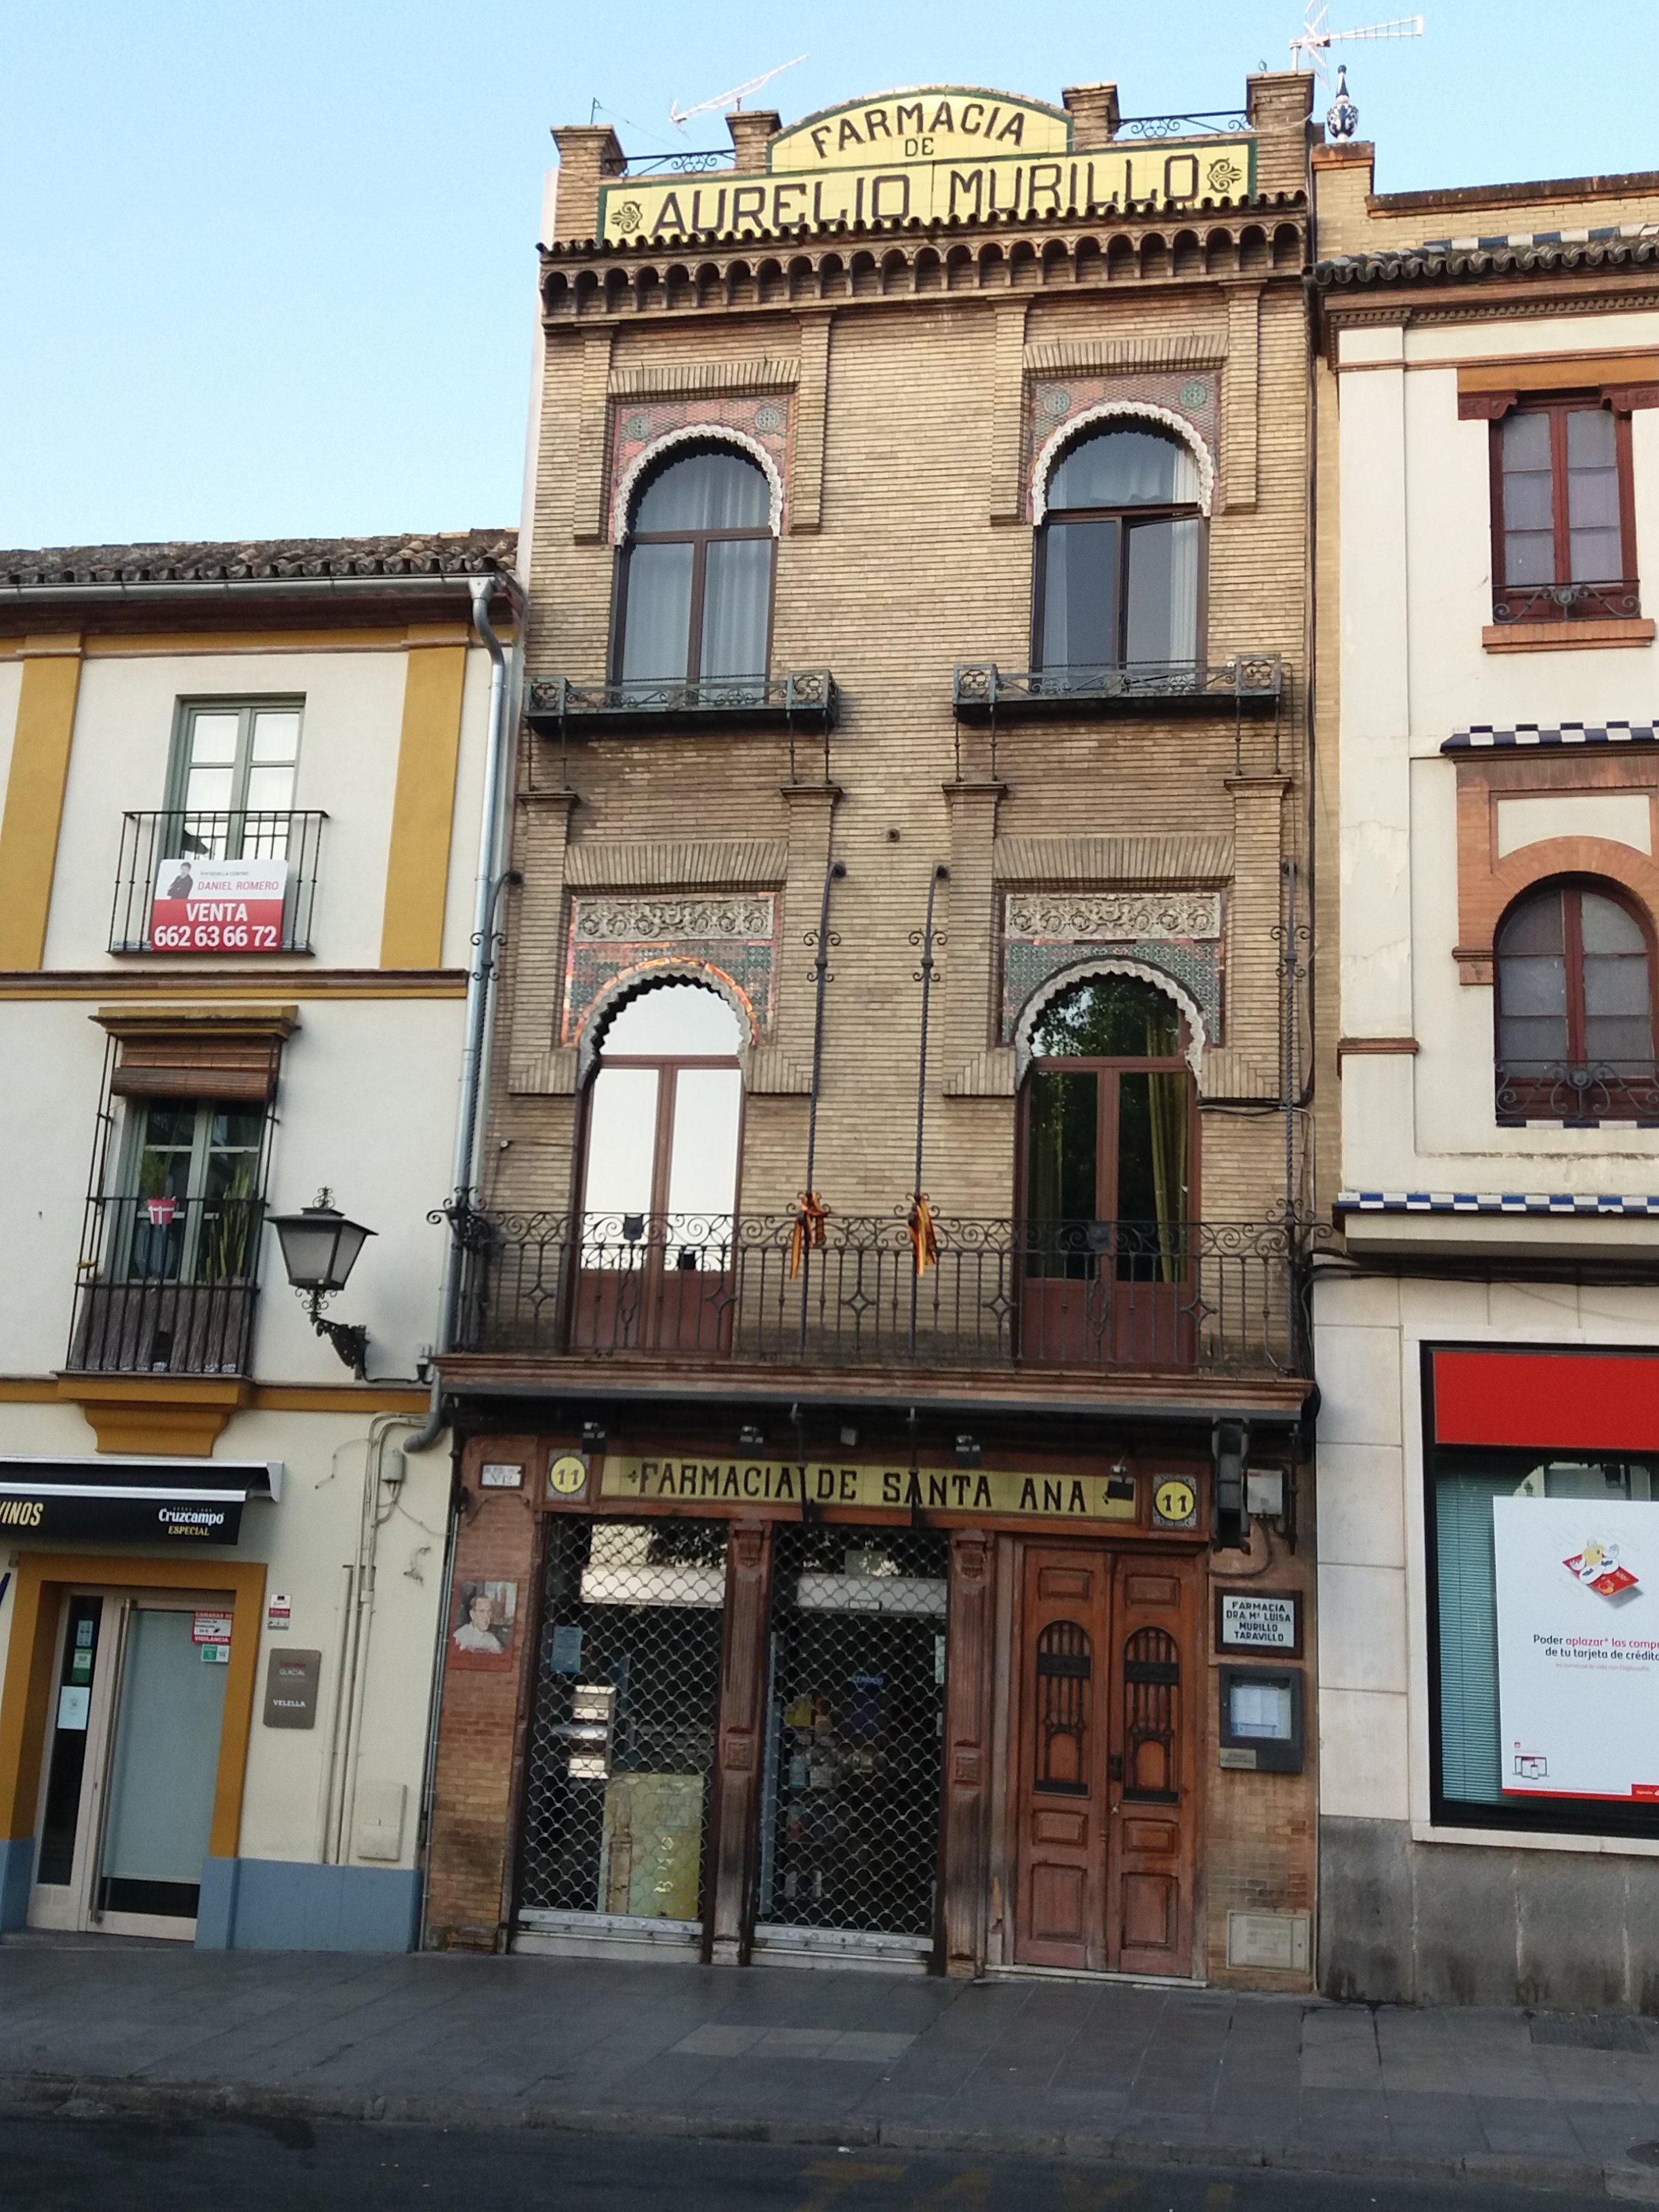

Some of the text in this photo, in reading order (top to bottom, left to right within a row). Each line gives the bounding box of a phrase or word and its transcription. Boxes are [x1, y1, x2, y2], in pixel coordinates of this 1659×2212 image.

[811, 100, 1025, 159] FARMACIA
[904, 137, 935, 157] DE
[650, 154, 1199, 237] AURELIO MURILLO
[198, 881, 279, 890] DANIEL ROMERO
[186, 903, 248, 922] VENTA
[154, 926, 278, 947] 662 63 66 72
[557, 1468, 579, 1486] 11
[640, 1462, 1086, 1513] FARMACIA DE SANTA ANA
[1162, 1494, 1187, 1513] 11
[159, 1507, 224, 1526] Cruzcampo
[168, 1525, 210, 1536] ESPECIAL
[1232, 1601, 1286, 1612] FARMACIA
[1226, 1610, 1246, 1620] DRA
[1264, 1613, 1291, 1622] LUISA
[1239, 1622, 1278, 1632] MURILLO
[1234, 1631, 1284, 1642] TARAVILLO
[1533, 1635, 1563, 1645] Poder
[1612, 1638, 1626, 1647] las
[1545, 1647, 1557, 1656] de
[1560, 1648, 1571, 1658] tu
[1574, 1649, 1608, 1660] tarjeta
[1610, 1650, 1623, 1659] de
[272, 1699, 306, 1707] VELELLA
